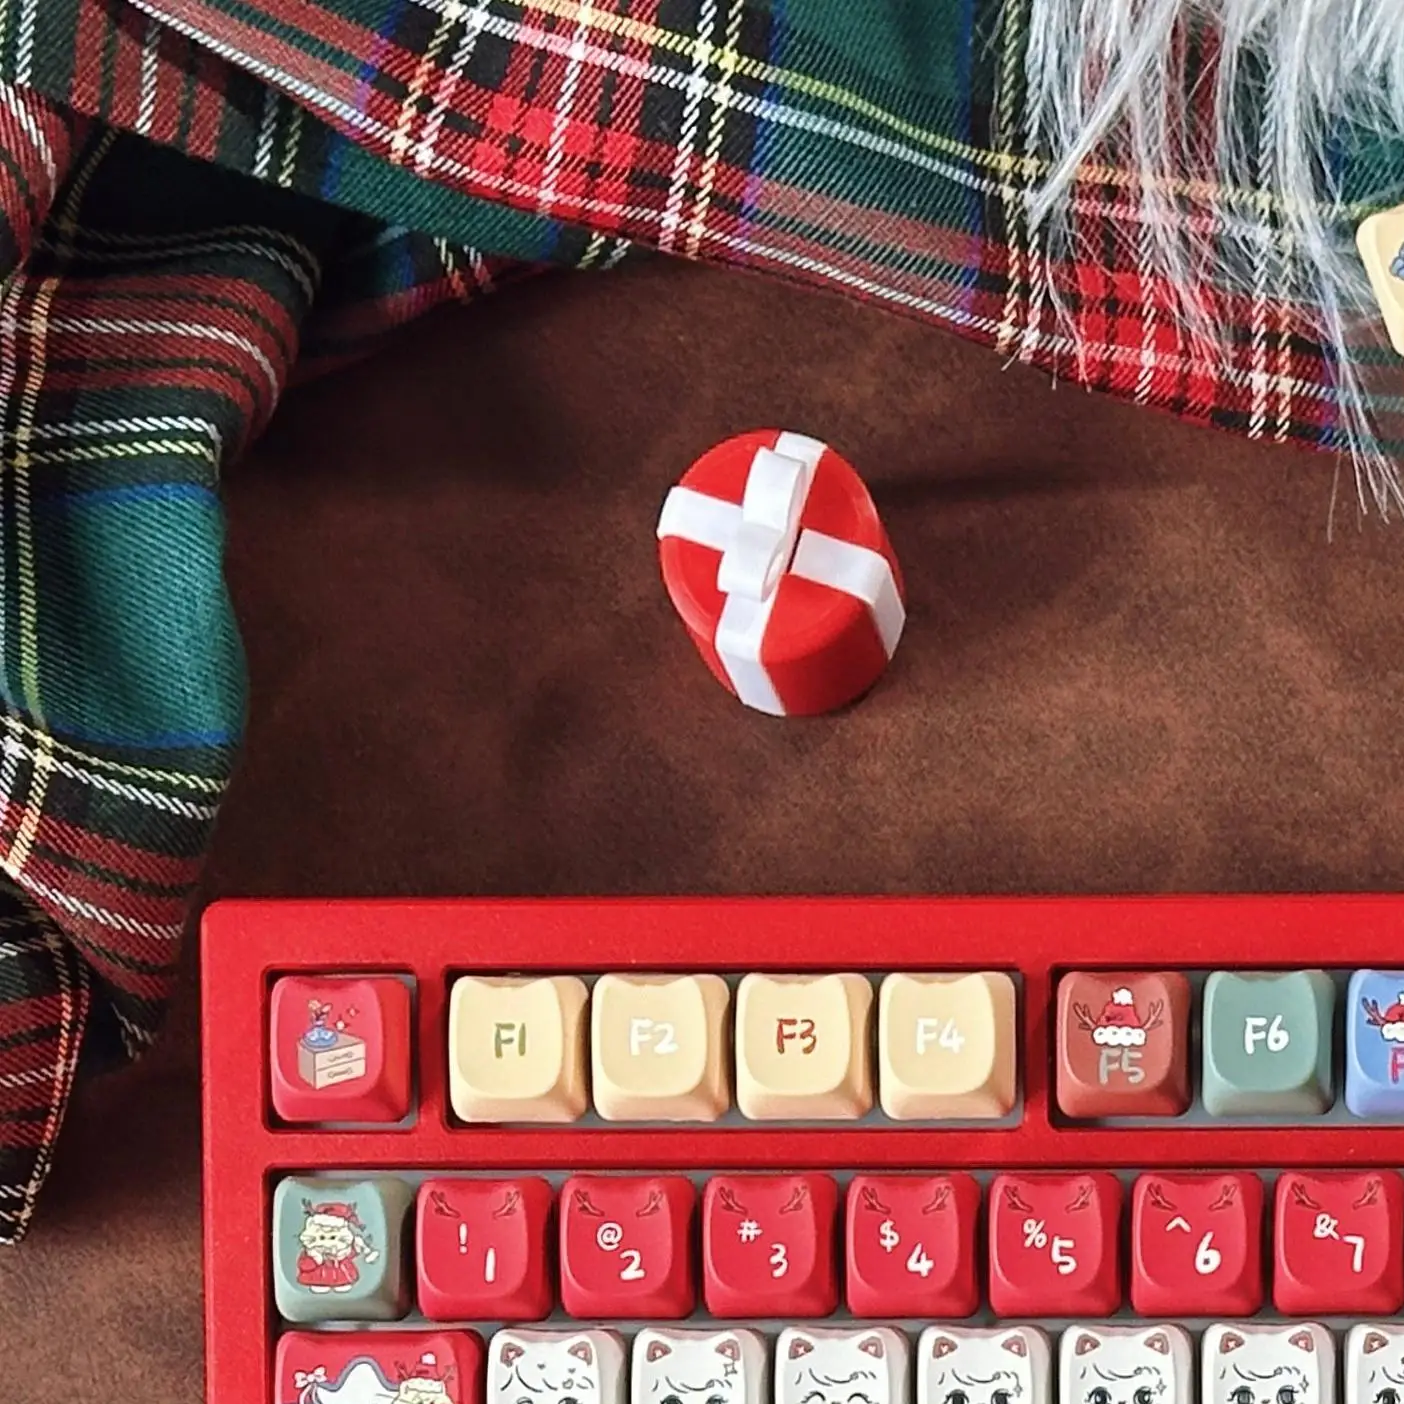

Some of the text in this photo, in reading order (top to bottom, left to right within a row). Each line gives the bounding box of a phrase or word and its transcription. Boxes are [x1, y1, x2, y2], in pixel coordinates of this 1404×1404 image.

[494, 1022, 527, 1059] F1
[630, 1018, 679, 1056] F2
[775, 1017, 818, 1056] F3
[917, 1018, 965, 1055] F4
[1245, 1014, 1289, 1054] F6
[1098, 1045, 1146, 1086] F5
[485, 1248, 495, 1282] 1
[620, 1250, 645, 1280] 2
[770, 1243, 788, 1277] 3
[907, 1243, 934, 1277] 4
[1051, 1236, 1077, 1274] 5
[1195, 1232, 1221, 1274] 6
[1343, 1235, 1364, 1272] 7
